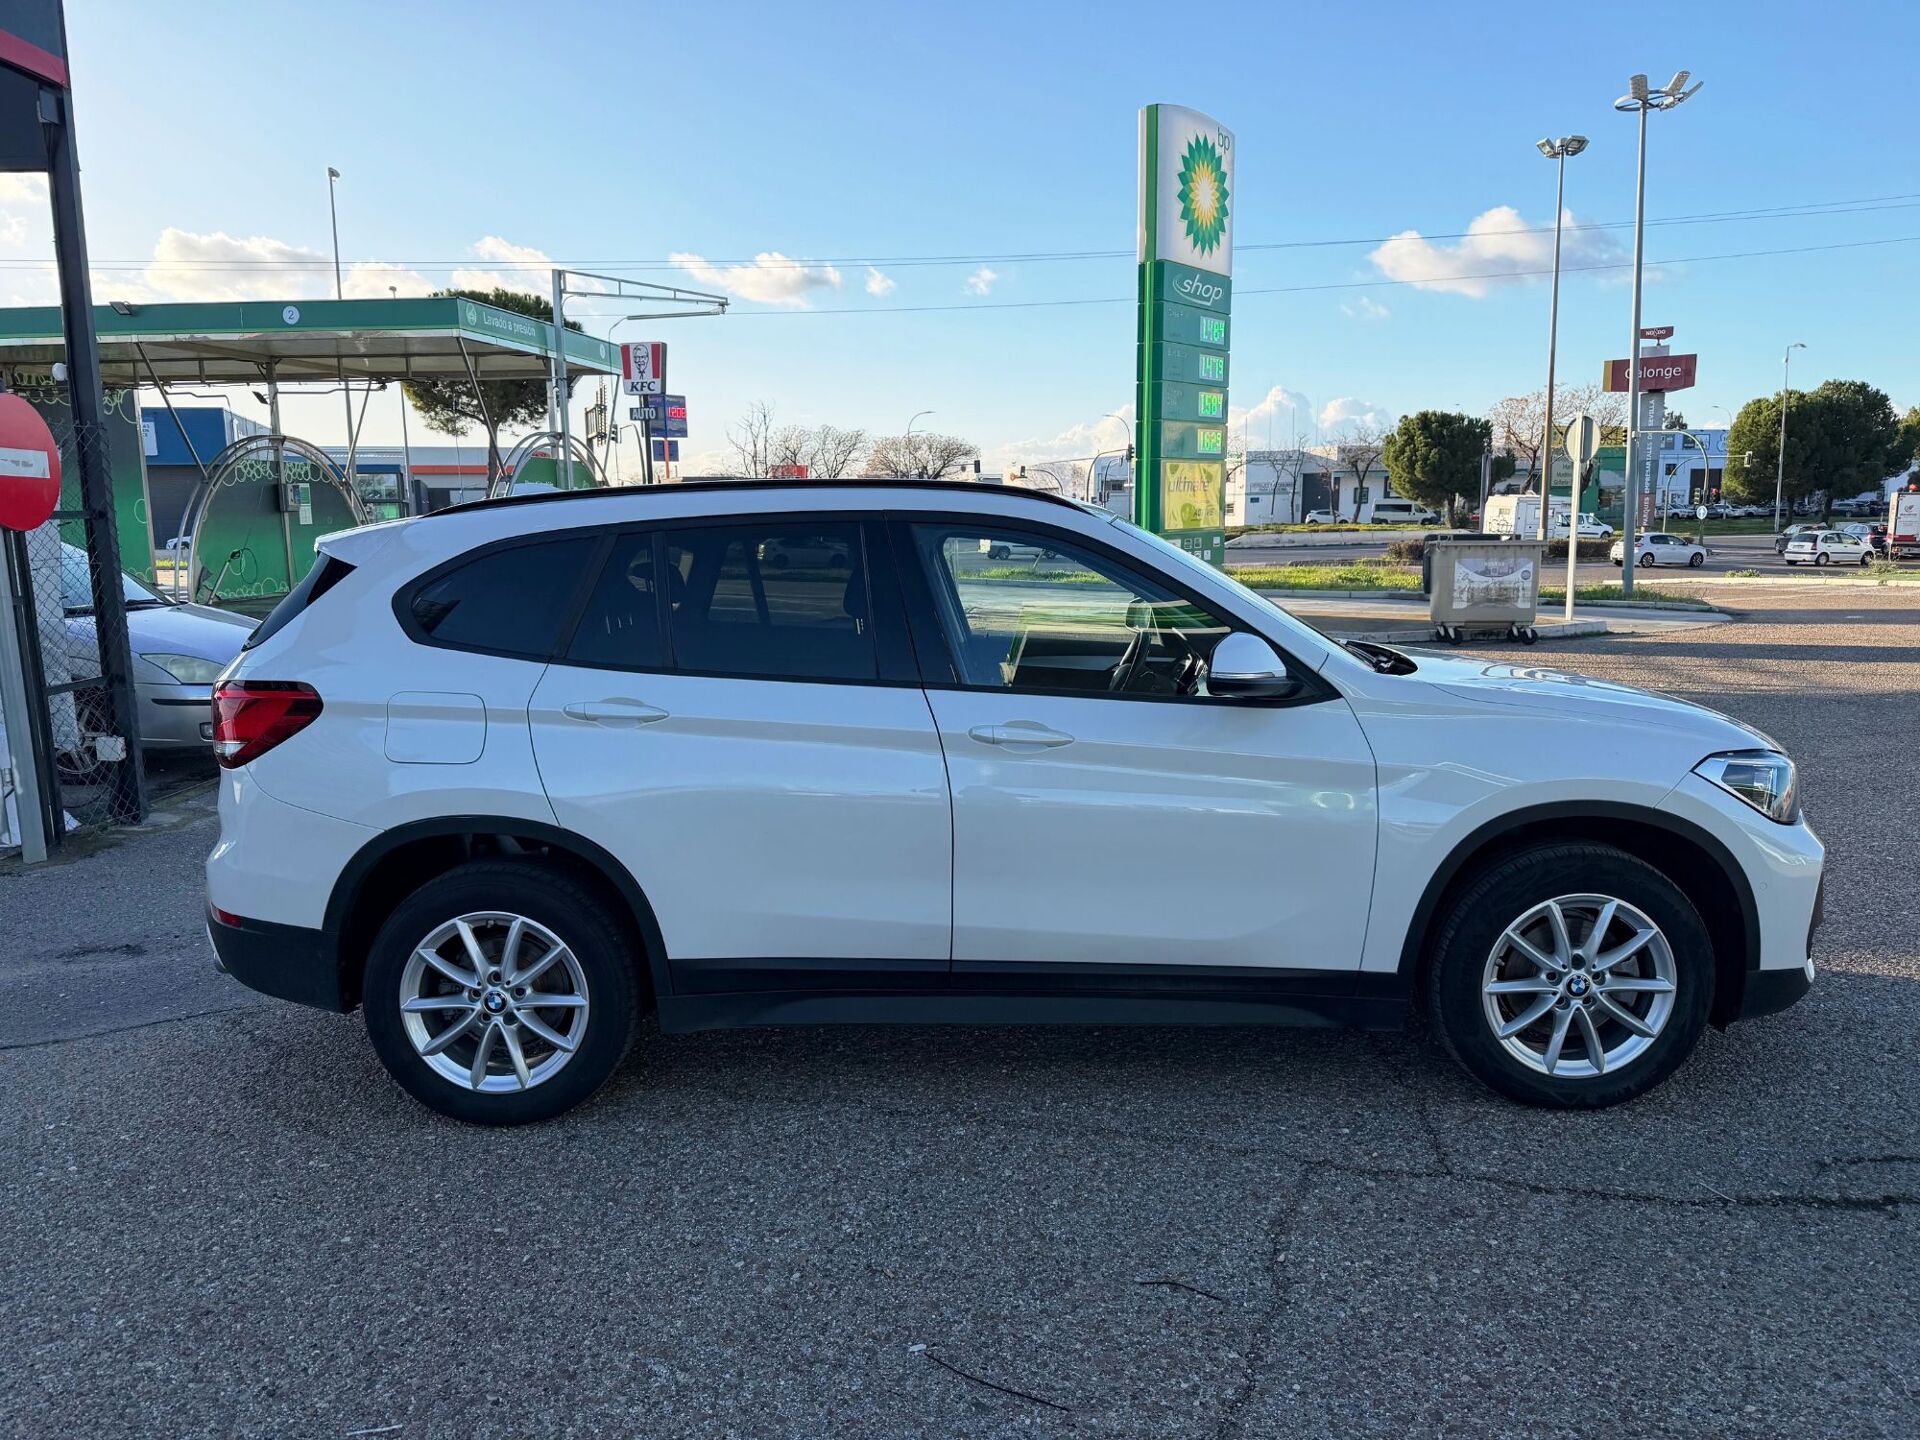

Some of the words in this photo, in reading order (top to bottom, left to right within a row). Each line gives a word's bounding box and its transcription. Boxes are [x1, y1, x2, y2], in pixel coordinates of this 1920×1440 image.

[1217, 126, 1230, 154] bp
[1183, 274, 1223, 305] shop
[287, 309, 295, 320] 2
[483, 311, 507, 329] Lavado
[507, 321, 513, 331] a
[513, 322, 536, 337] presión
[630, 381, 656, 392] KFC
[632, 408, 656, 420] AUTO
[1642, 496, 1650, 526] PARQUES
[1648, 399, 1656, 427] SEVILLA
